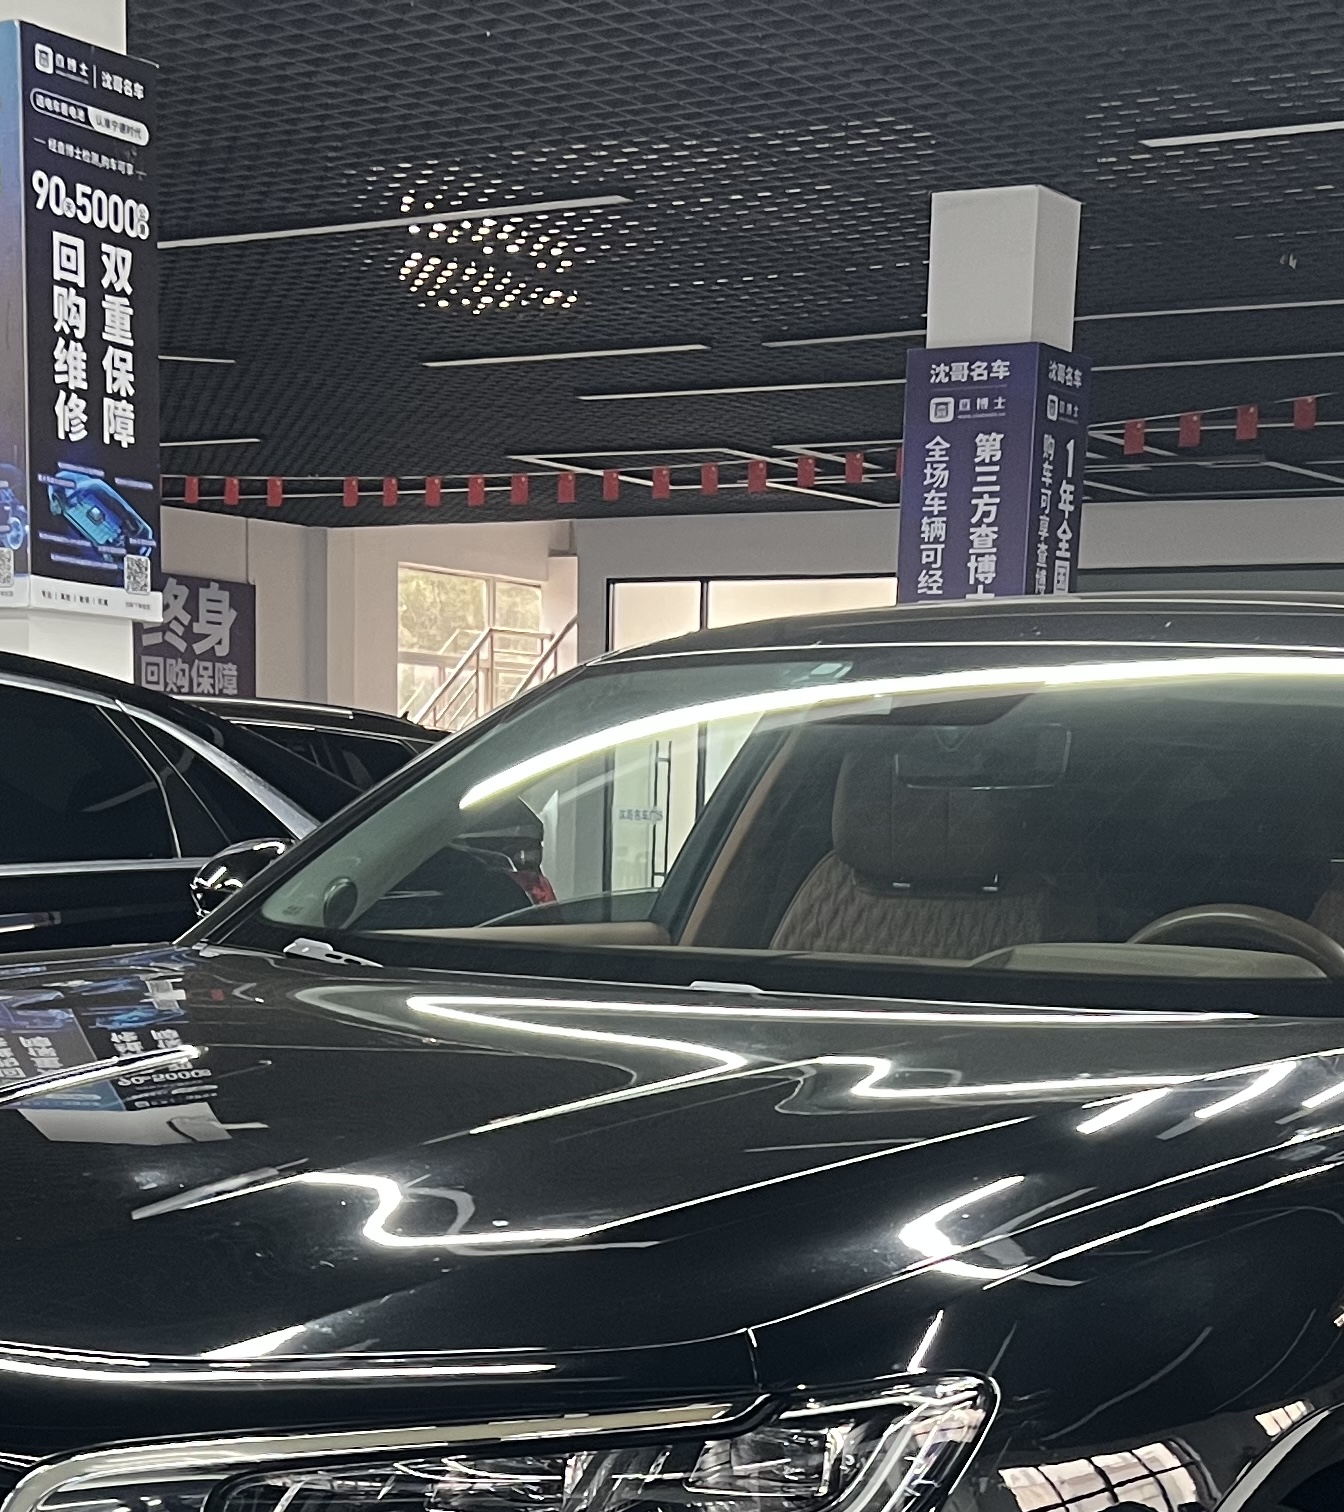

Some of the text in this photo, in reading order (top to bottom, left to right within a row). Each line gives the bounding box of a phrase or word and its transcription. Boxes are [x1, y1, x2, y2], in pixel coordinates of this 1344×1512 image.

[52, 230, 88, 443] 回购维修
[100, 241, 136, 449] 双重保障
[930, 359, 1011, 384] 沈哥名车
[1048, 359, 1083, 389] 沈哥名车
[917, 435, 951, 596] 全场车辆可经
[141, 577, 238, 657] 终身
[140, 655, 238, 695] 回购保障
